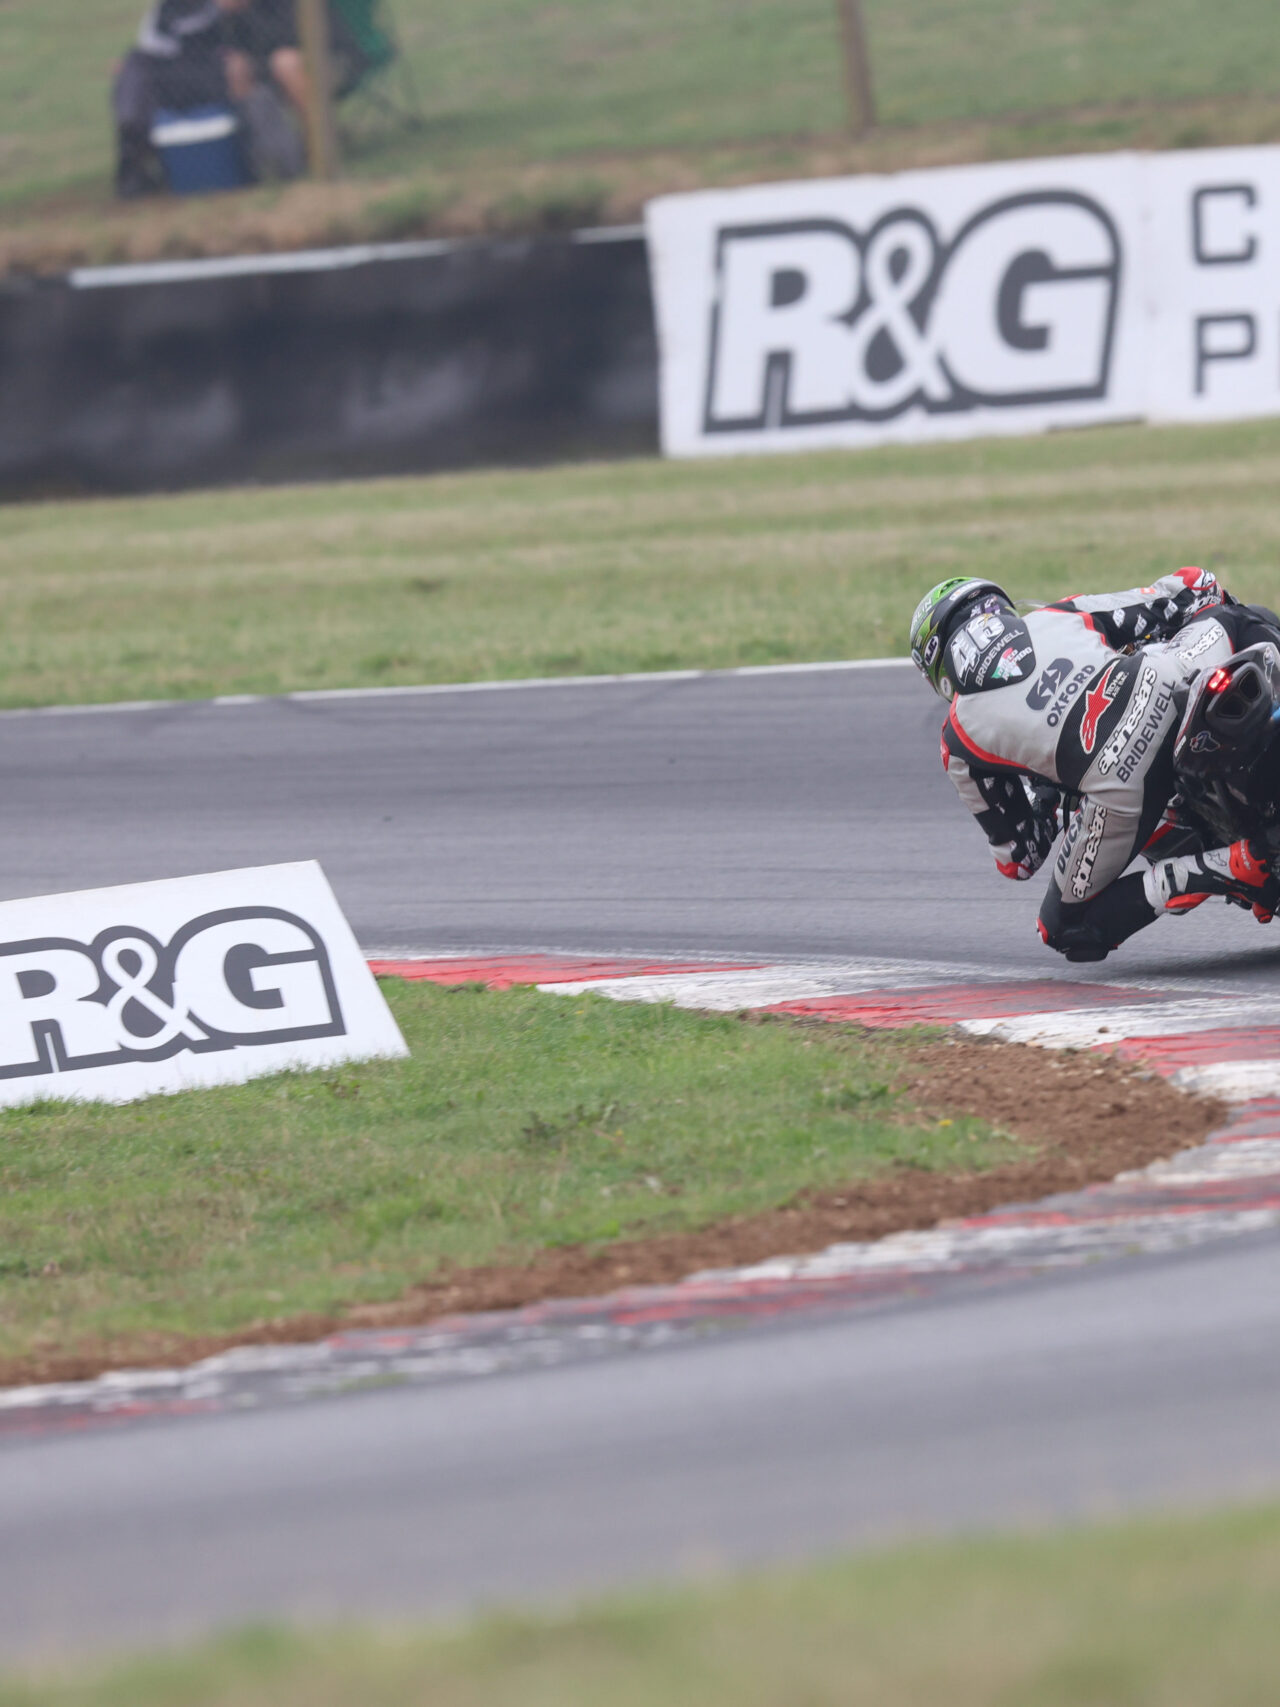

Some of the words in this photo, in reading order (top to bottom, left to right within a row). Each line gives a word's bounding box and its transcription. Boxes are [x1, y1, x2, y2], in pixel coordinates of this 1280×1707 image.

[702, 189, 1122, 434] R&G
[951, 615, 1005, 687] 46
[975, 628, 1025, 687] BRIDEWELL
[1046, 664, 1096, 728] OXFORD
[1098, 667, 1157, 776] alpinestars
[1116, 680, 1176, 783] BRIDEWELL
[1072, 804, 1108, 899] alpinestars
[0, 906, 347, 1080] R&G
